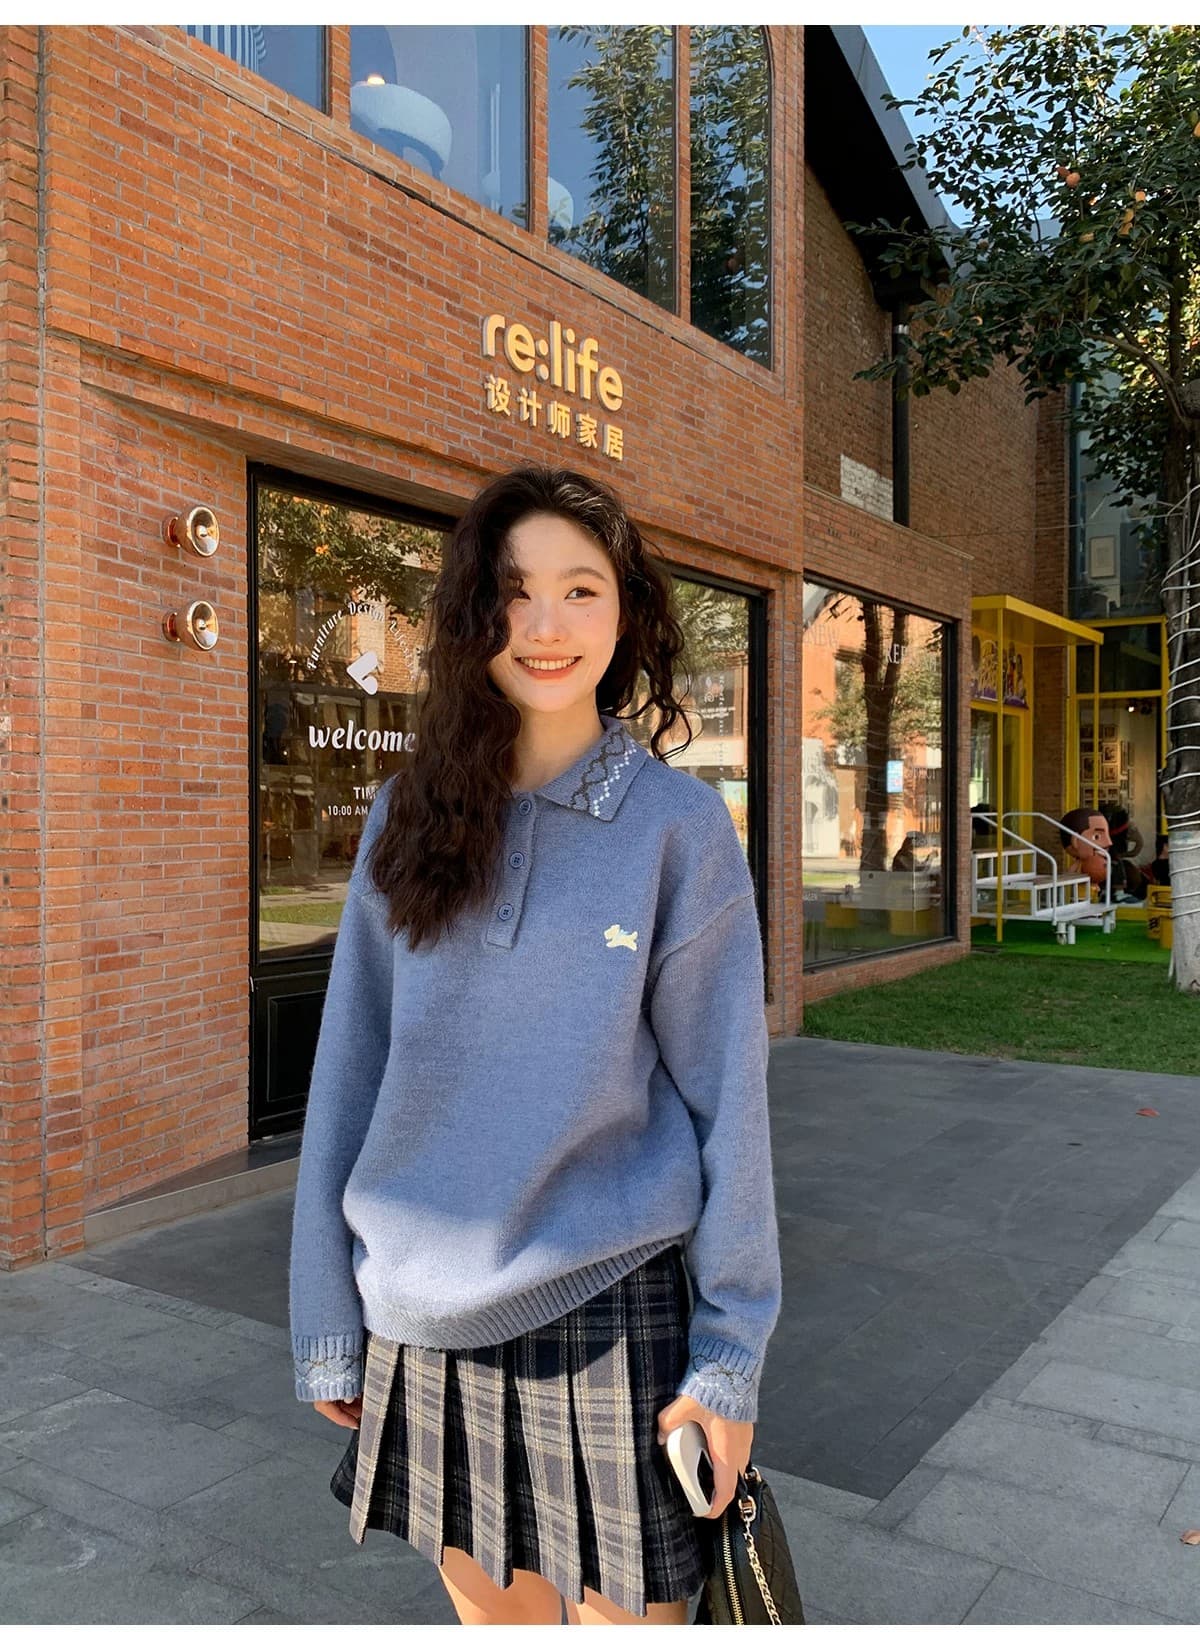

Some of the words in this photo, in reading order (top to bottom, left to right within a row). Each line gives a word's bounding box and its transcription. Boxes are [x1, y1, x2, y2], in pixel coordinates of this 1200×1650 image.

[483, 313, 624, 412] re:life
[484, 374, 624, 462] 设计师家居
[306, 610, 344, 670] Furniture
[347, 601, 384, 623] Design
[308, 719, 416, 753] welcome
[328, 804, 352, 816] 10:00
[354, 804, 369, 816] AM
[352, 786, 377, 800] TIM
